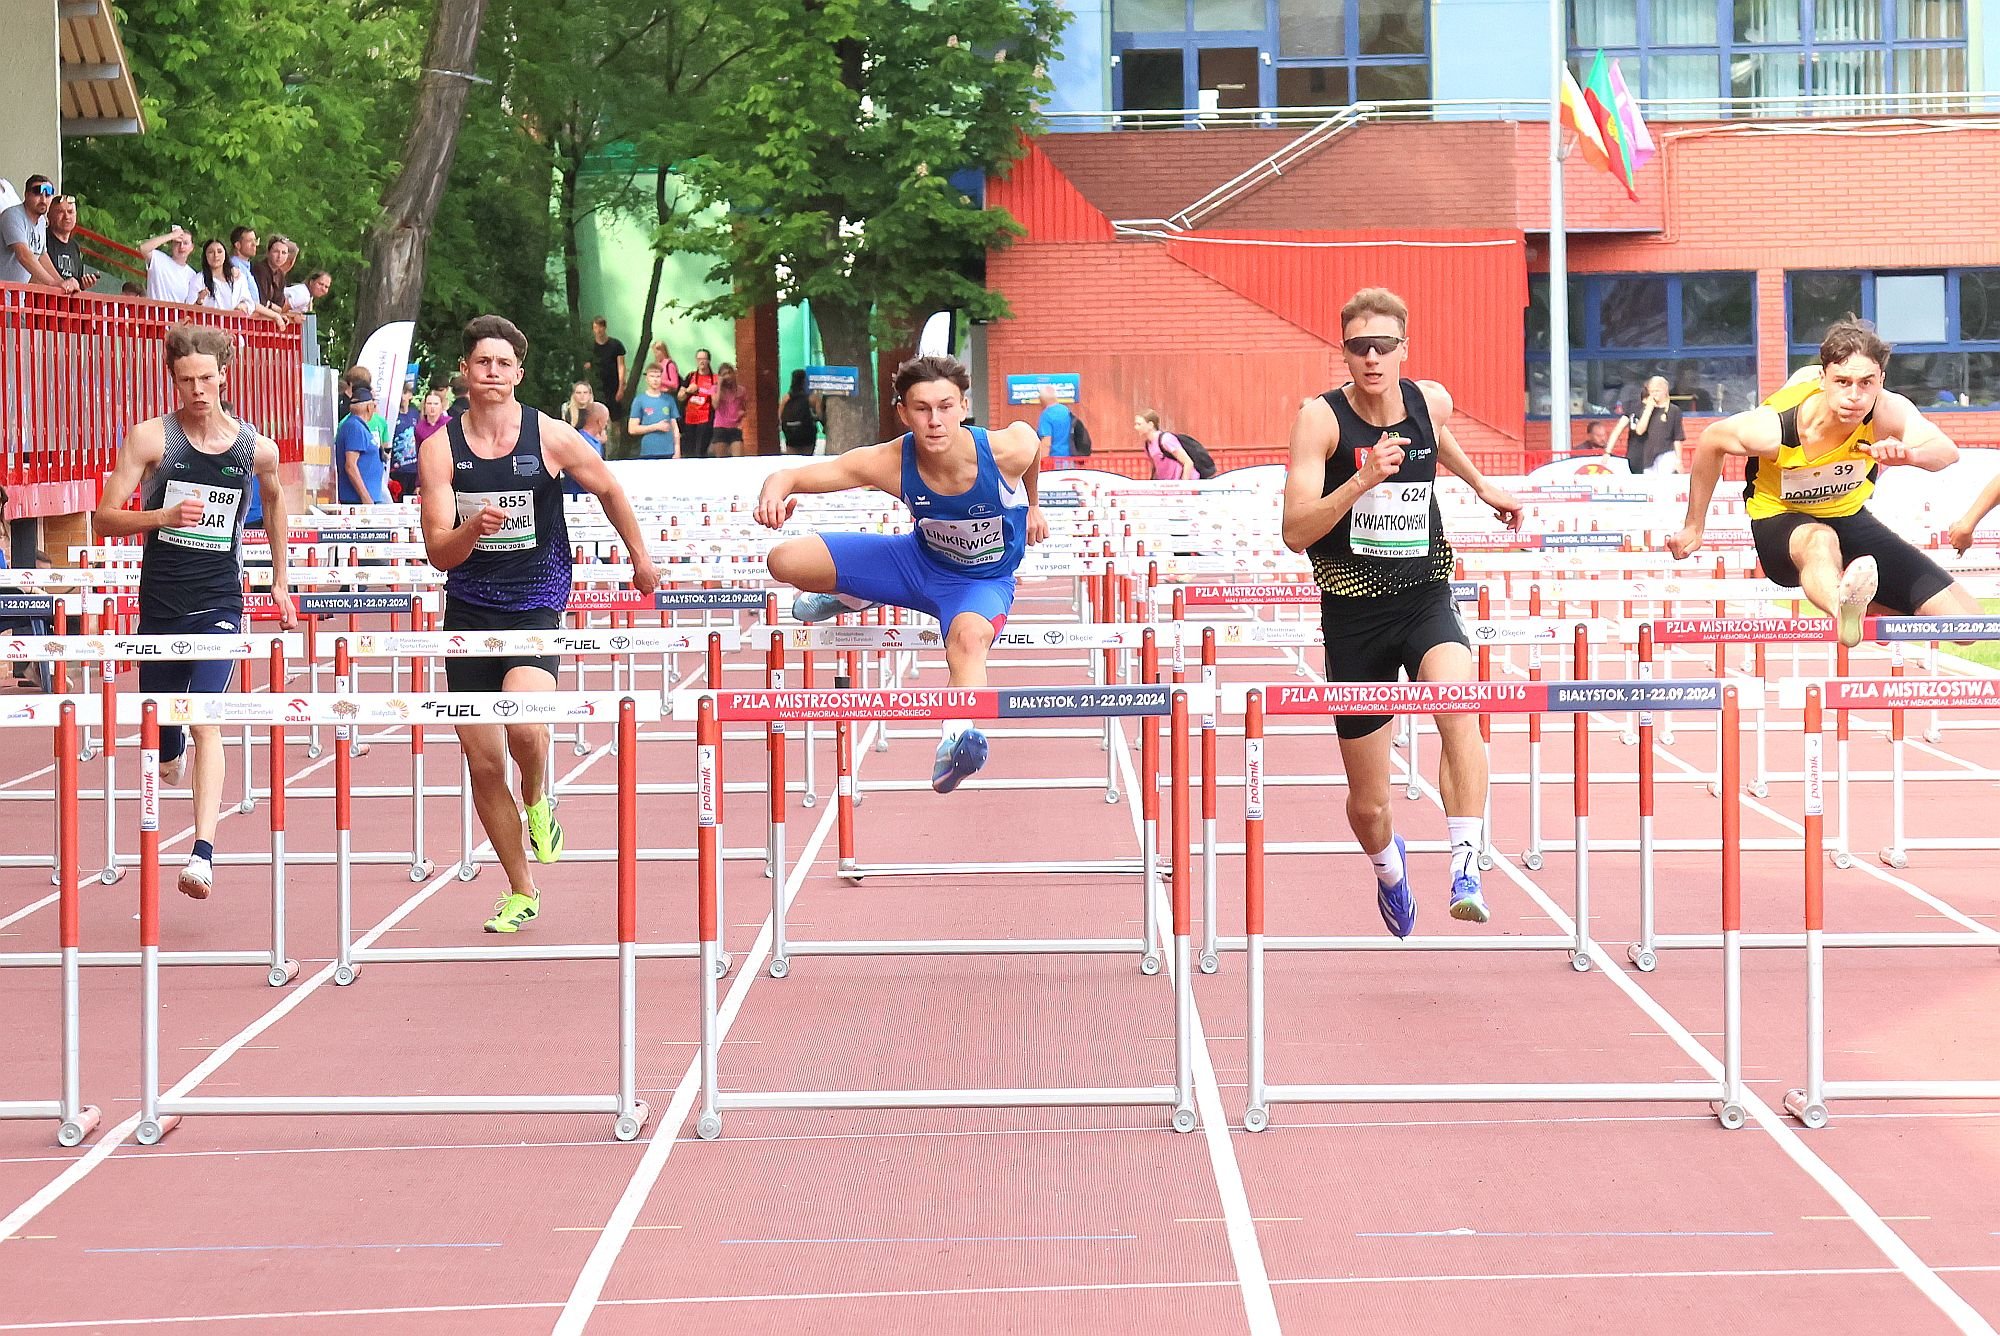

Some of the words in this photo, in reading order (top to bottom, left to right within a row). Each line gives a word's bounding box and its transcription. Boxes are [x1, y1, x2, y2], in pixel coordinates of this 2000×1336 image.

[1834, 464, 1854, 476] 39
[208, 491, 235, 504] 888
[1401, 487, 1427, 502] 624
[498, 495, 527, 508] 855
[971, 521, 991, 533] 19
[1354, 512, 1427, 531] KWIATKOWSKI
[926, 528, 1000, 551] LINKIEWICZ
[1362, 547, 1403, 556] BIAŁYSTOK
[585, 592, 620, 602] POLSKI
[622, 592, 641, 602] U16
[1195, 587, 1220, 598] PZLA
[1222, 586, 1292, 597] MISTRZOSTWA
[1295, 586, 1321, 596] POLS
[127, 597, 139, 608] PZ
[242, 596, 264, 606] LSKI
[306, 599, 351, 609] BIAŁYSTOK,
[353, 598, 408, 608] 21-22.09.2024
[662, 593, 707, 604] BIAŁYSTOK,
[708, 593, 763, 603] 21-22.09.2024
[1666, 621, 1696, 633] PZLA
[1699, 620, 1788, 633] MISTRZOSTWA
[1790, 619, 1833, 631] POLSKI
[1886, 622, 1941, 634] BIAŁYSTOK,
[999, 633, 1035, 644] FUEL
[126, 645, 162, 654] FUEL
[565, 640, 600, 650] FUEL
[1282, 687, 1319, 702] PZLA
[1323, 686, 1433, 702] MISTRZOSTWA
[1438, 686, 1492, 701] POLSKI
[1496, 685, 1526, 700] U16
[1559, 689, 1629, 702] BIAŁYSTOK,
[1631, 687, 1716, 701] 21-22.09.2024
[1841, 683, 1879, 698] PZLA
[1882, 681, 1995, 697] MISTRZOSTWA
[733, 693, 770, 708] PZLA
[775, 693, 884, 708] MISTRZOSTWA
[889, 692, 942, 707] POLSKI
[947, 691, 977, 706] U16
[1009, 696, 1078, 709] BIAŁYSTOK,
[1080, 693, 1166, 708] 21-22.09.2024
[421, 701, 437, 709] 4F
[436, 704, 480, 717] FUEL
[525, 704, 556, 713] Okęcie
[1422, 702, 1480, 710] KUSOCIŃSKIEGO
[873, 709, 931, 717] KUSOCIŃSKIEGO
[1249, 760, 1261, 804] polanik
[1808, 755, 1821, 799] polanik
[144, 771, 155, 815] polanik
[701, 767, 713, 811] polanik
